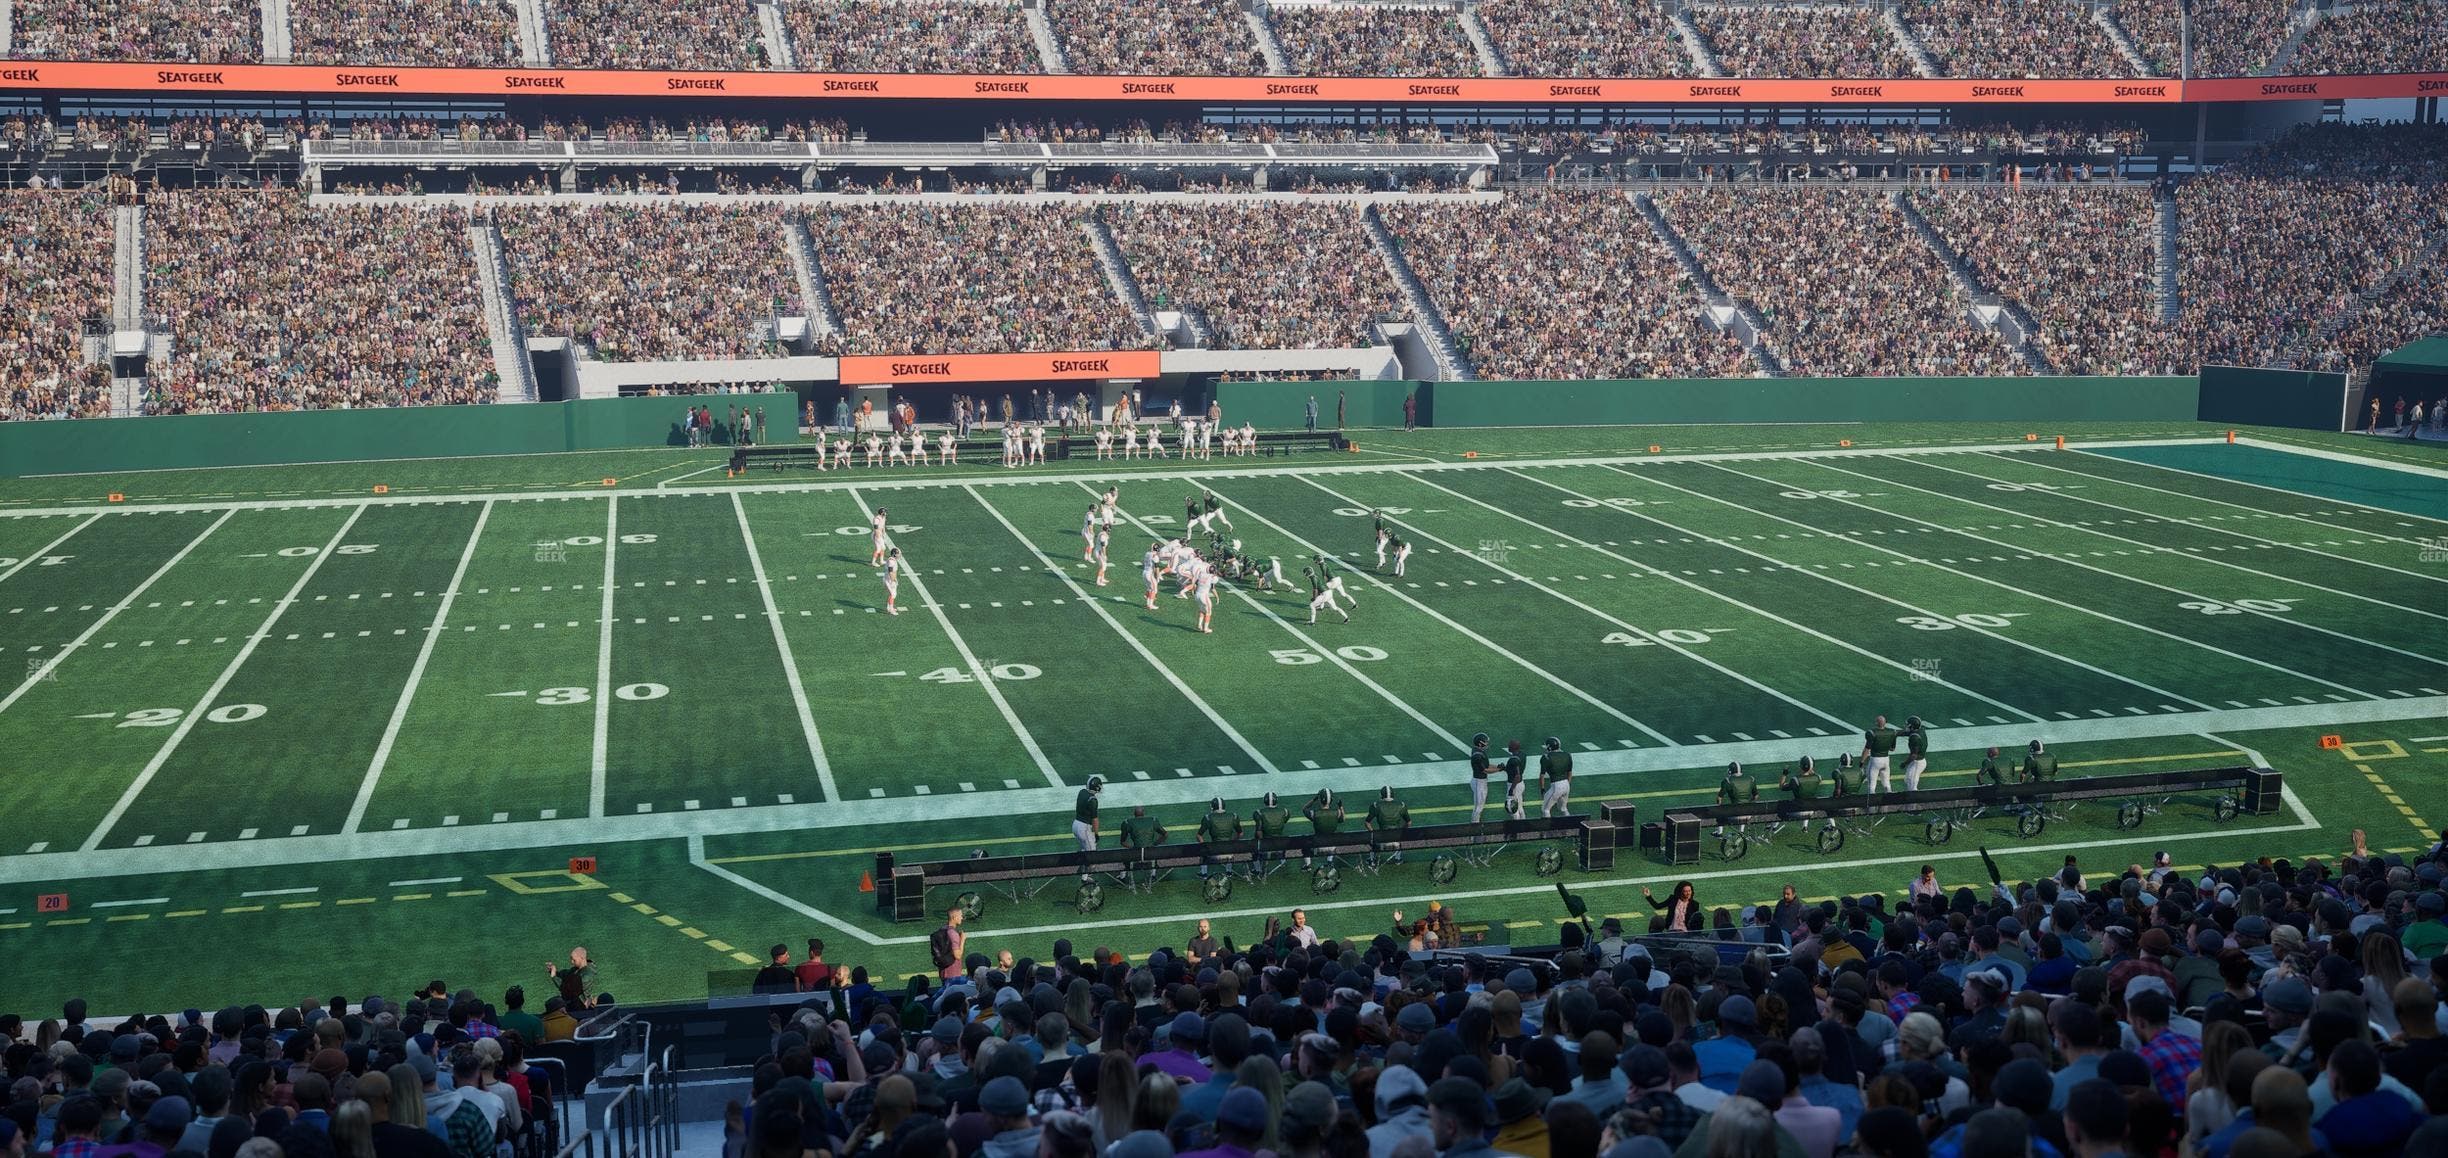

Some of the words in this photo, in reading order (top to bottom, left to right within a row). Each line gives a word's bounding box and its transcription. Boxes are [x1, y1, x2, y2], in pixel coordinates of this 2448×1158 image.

[0, 69, 40, 82] GEEK
[158, 71, 224, 85] SEATGEEK
[336, 73, 399, 87] SEATGEEK
[505, 76, 566, 89] SEATGEEK
[668, 78, 726, 91] SEATGEEK
[824, 80, 879, 92] SEATGEEK
[976, 81, 1029, 94] SEATGEEK
[1123, 82, 1175, 95] SEATGEEK
[1267, 83, 1319, 95] SEATGEEK
[2261, 82, 2318, 95] SEATGEEK
[1409, 84, 1460, 96] SEATGEEK
[1550, 85, 1601, 97] SEATGEEK
[1690, 85, 1741, 97] SEATGEEK
[1831, 86, 1882, 97] SEATGEEK
[1972, 86, 2024, 97] SEATGEEK
[2115, 86, 2166, 97] SEATGEEK
[892, 362, 951, 376] SEATGEEK
[1052, 359, 1109, 373] SEATGEEK
[1896, 613, 2012, 631] 30
[1601, 629, 1712, 647] 40
[1268, 645, 1390, 666] 50
[919, 663, 1043, 684] 40
[536, 682, 670, 705] 30
[115, 703, 268, 728] 20
[2327, 737, 2338, 746] 30
[576, 860, 590, 871] 30
[45, 897, 60, 908] 20
